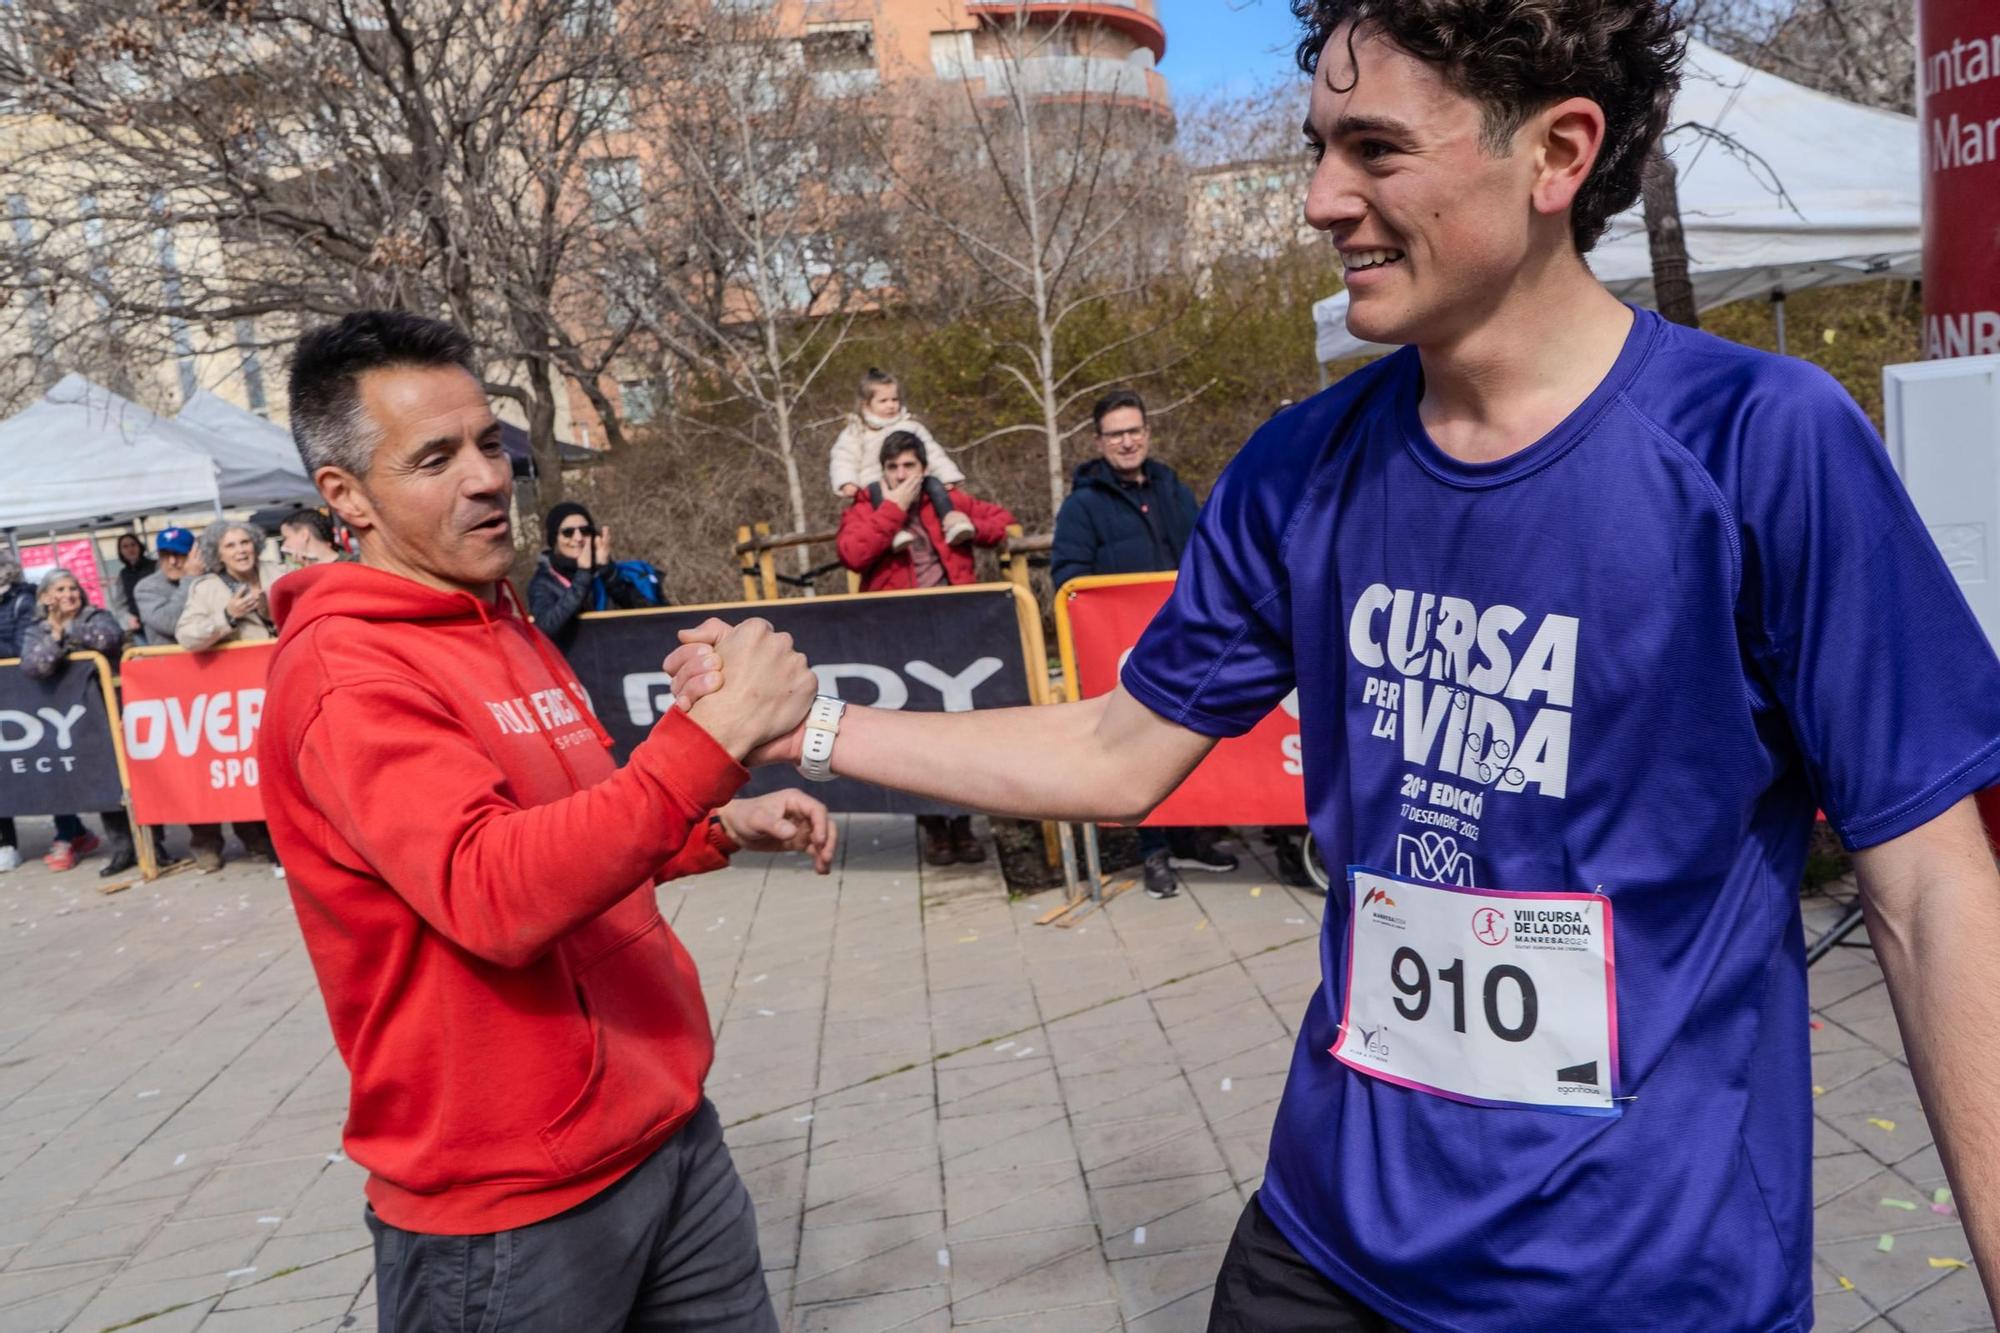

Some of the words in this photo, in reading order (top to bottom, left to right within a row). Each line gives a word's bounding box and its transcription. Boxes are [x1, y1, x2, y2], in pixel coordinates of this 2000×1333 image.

[1349, 582, 1580, 707] CURSA
[1362, 676, 1400, 710] PER
[1371, 709, 1398, 741] LA
[1403, 678, 1572, 799] VIDA
[1400, 803, 1410, 817] 17
[1408, 807, 1460, 832] DESEMBRE
[1429, 782, 1484, 820] EDICIÓ
[1514, 910, 1535, 922] VIII
[1537, 911, 1582, 923] CURSA
[1514, 922, 1531, 933] DE
[1534, 923, 1550, 934] LA
[1553, 924, 1591, 935] DONA
[1390, 946, 1539, 1043] 910
